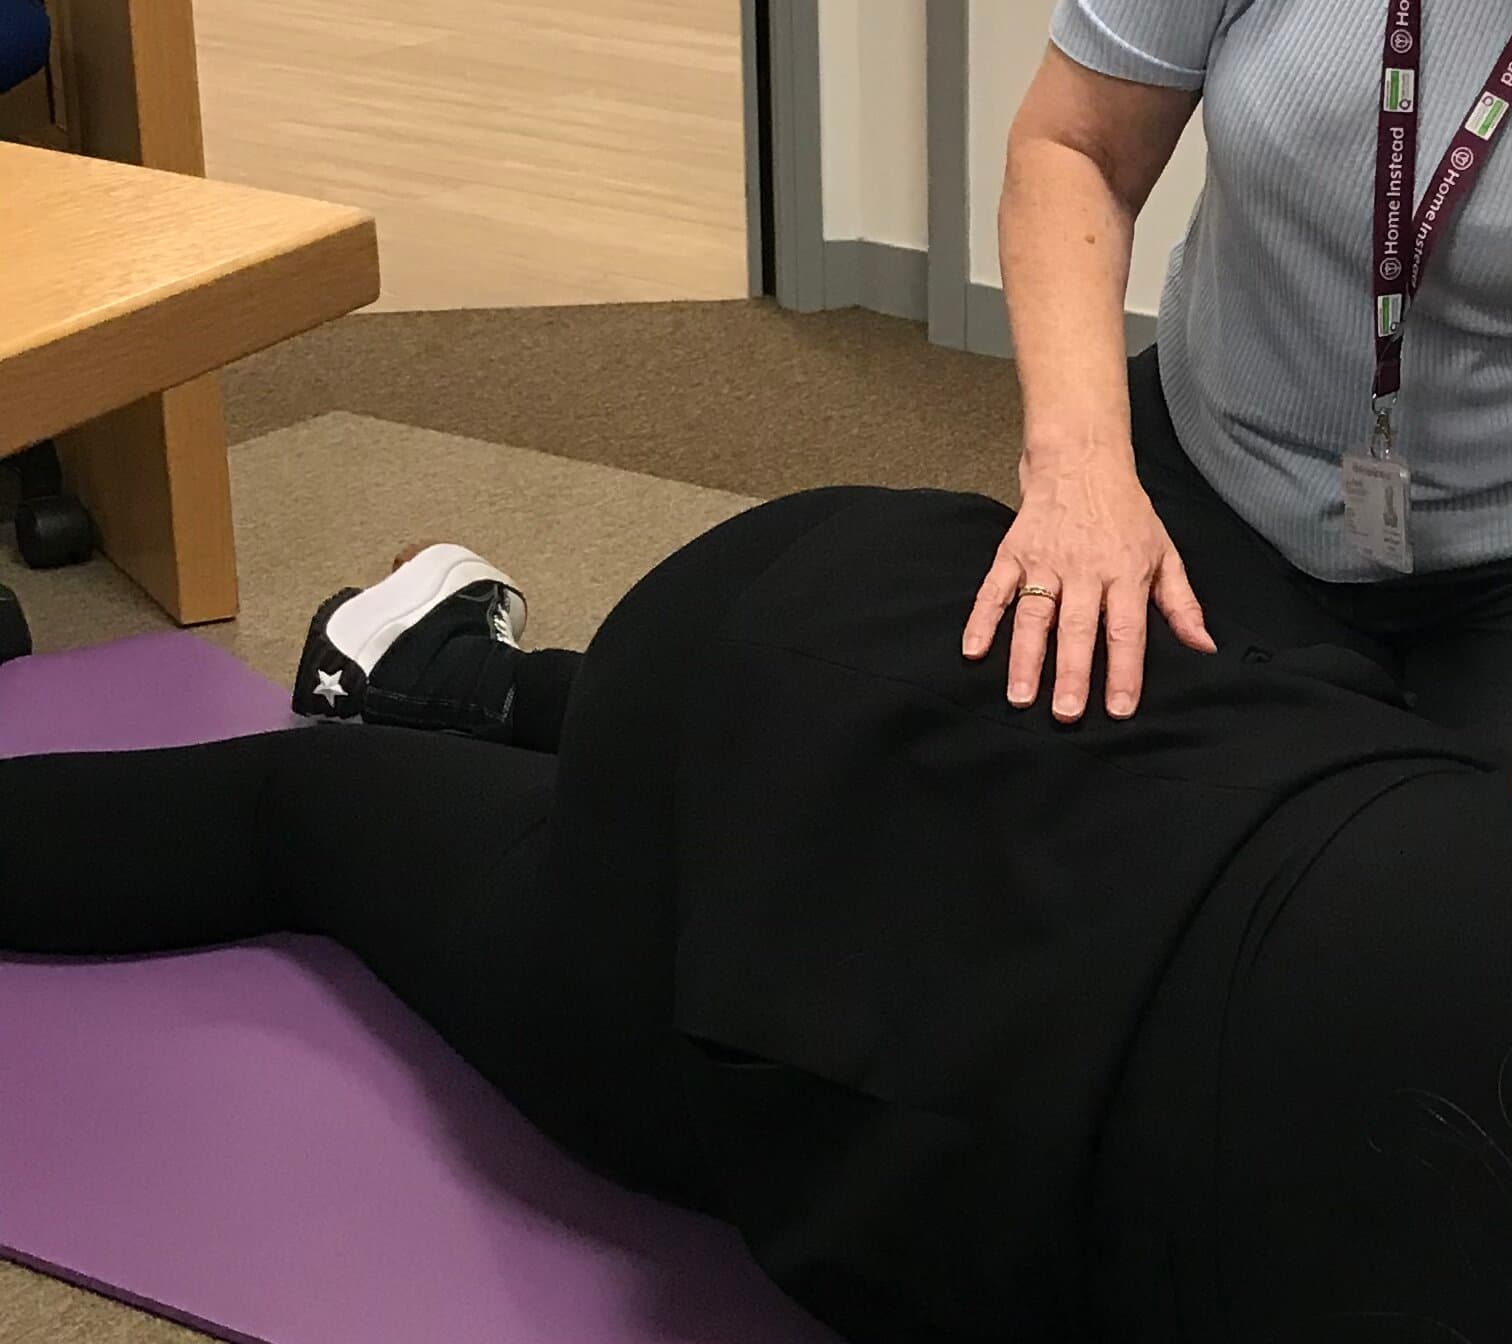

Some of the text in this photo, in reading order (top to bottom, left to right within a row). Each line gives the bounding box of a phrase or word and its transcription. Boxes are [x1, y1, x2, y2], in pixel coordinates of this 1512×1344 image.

[1386, 127, 1404, 197] Instead
[1425, 168, 1470, 222] Home
[1384, 199, 1400, 255] Home
